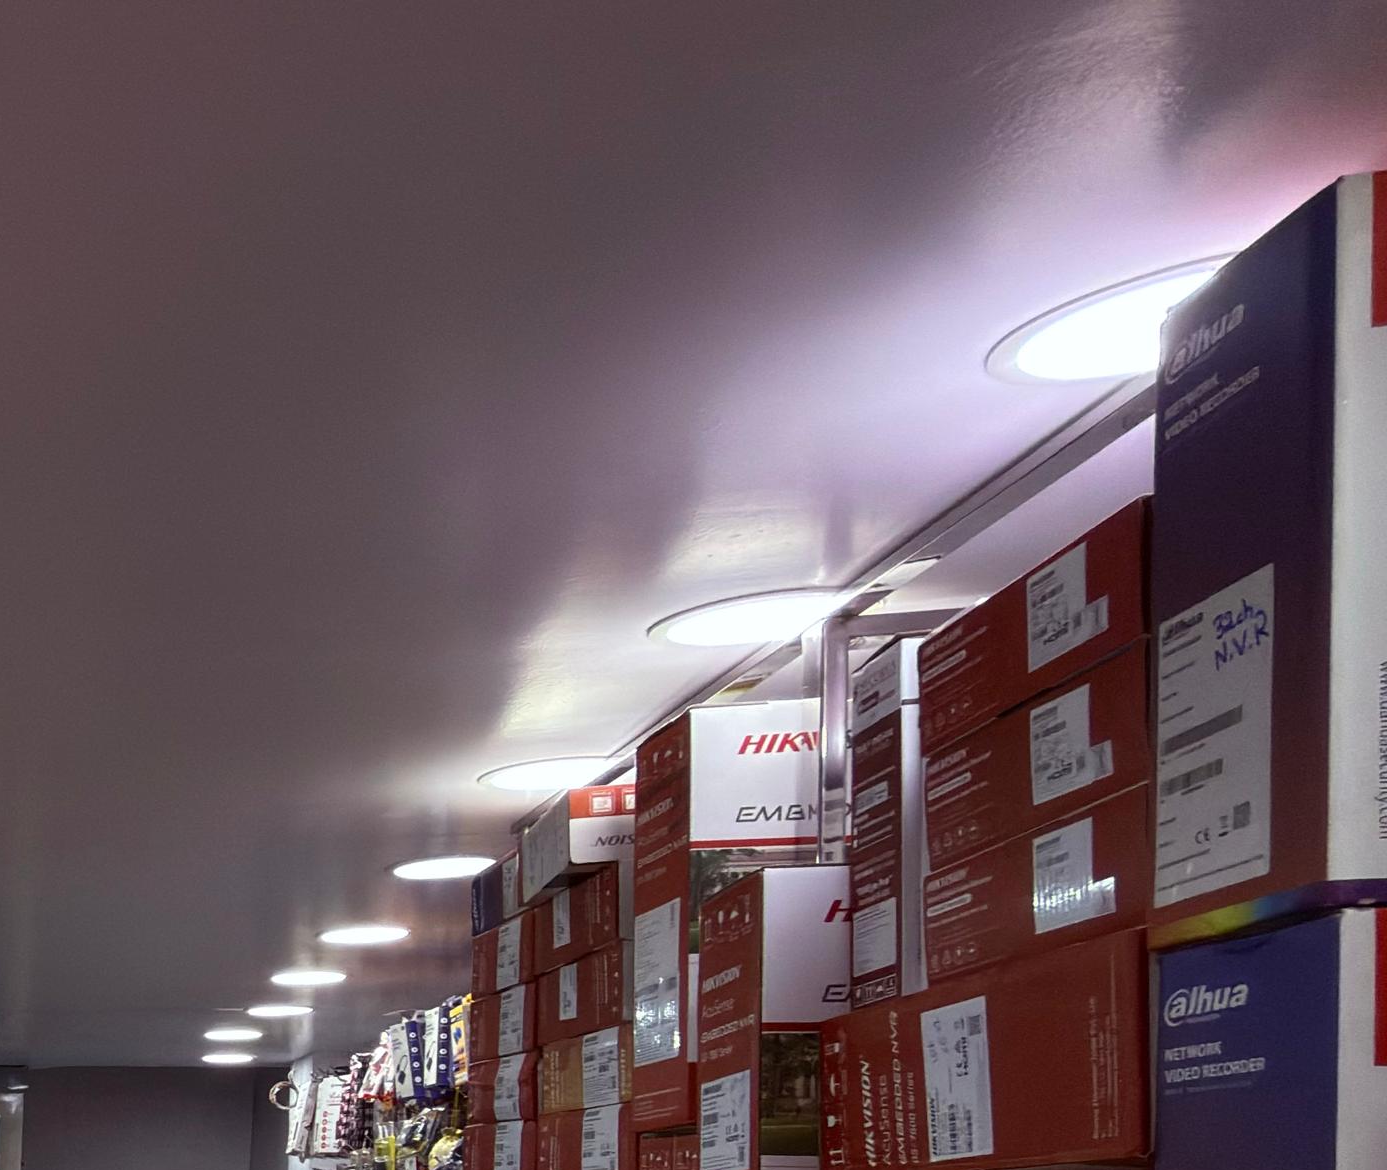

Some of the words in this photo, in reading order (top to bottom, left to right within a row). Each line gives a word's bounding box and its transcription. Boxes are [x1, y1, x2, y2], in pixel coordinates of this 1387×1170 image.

[890, 1010, 899, 1053] NVR
[1164, 1041, 1222, 1061] NETWORK
[1164, 1066, 1200, 1083] VIDEO
[1202, 1057, 1266, 1078] RECORDER
[860, 1054, 877, 1167] HIKVISION
[892, 1058, 907, 1165] EMBEDDED
